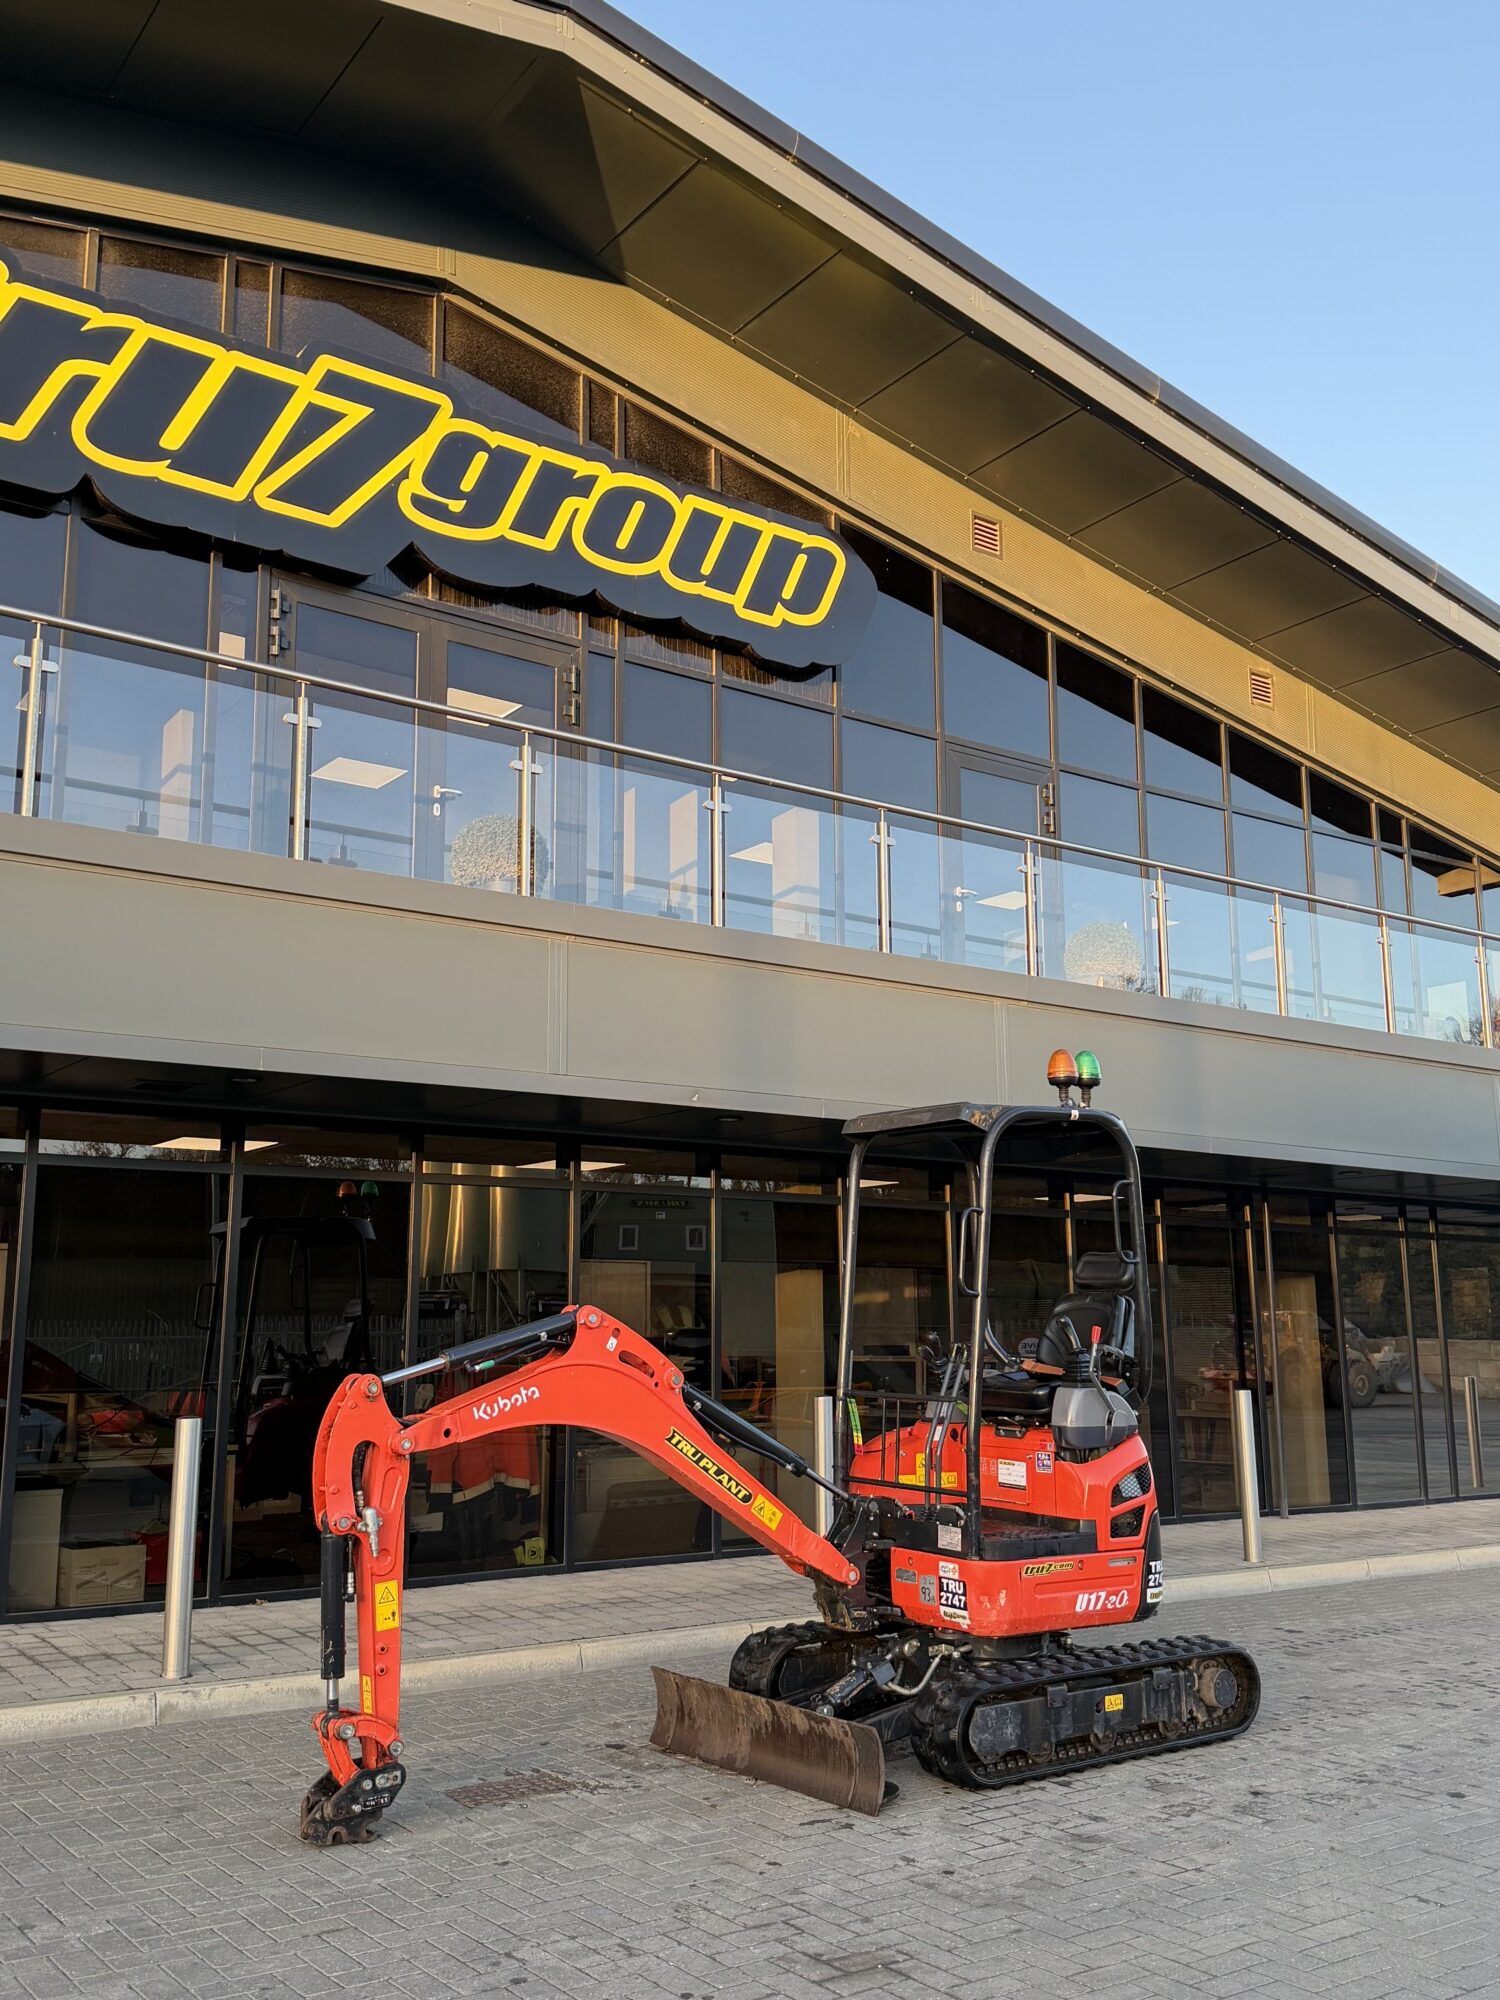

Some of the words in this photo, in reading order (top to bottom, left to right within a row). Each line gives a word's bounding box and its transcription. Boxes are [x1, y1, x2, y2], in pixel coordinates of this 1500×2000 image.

[0, 258, 846, 628] ru7group
[472, 1386, 540, 1420] Kubota
[670, 1432, 701, 1461] TRU
[699, 1457, 749, 1500] PLANT
[1023, 1561, 1074, 1577] tru7.com
[941, 1578, 964, 1594] TRU
[940, 1592, 966, 1608] 2747
